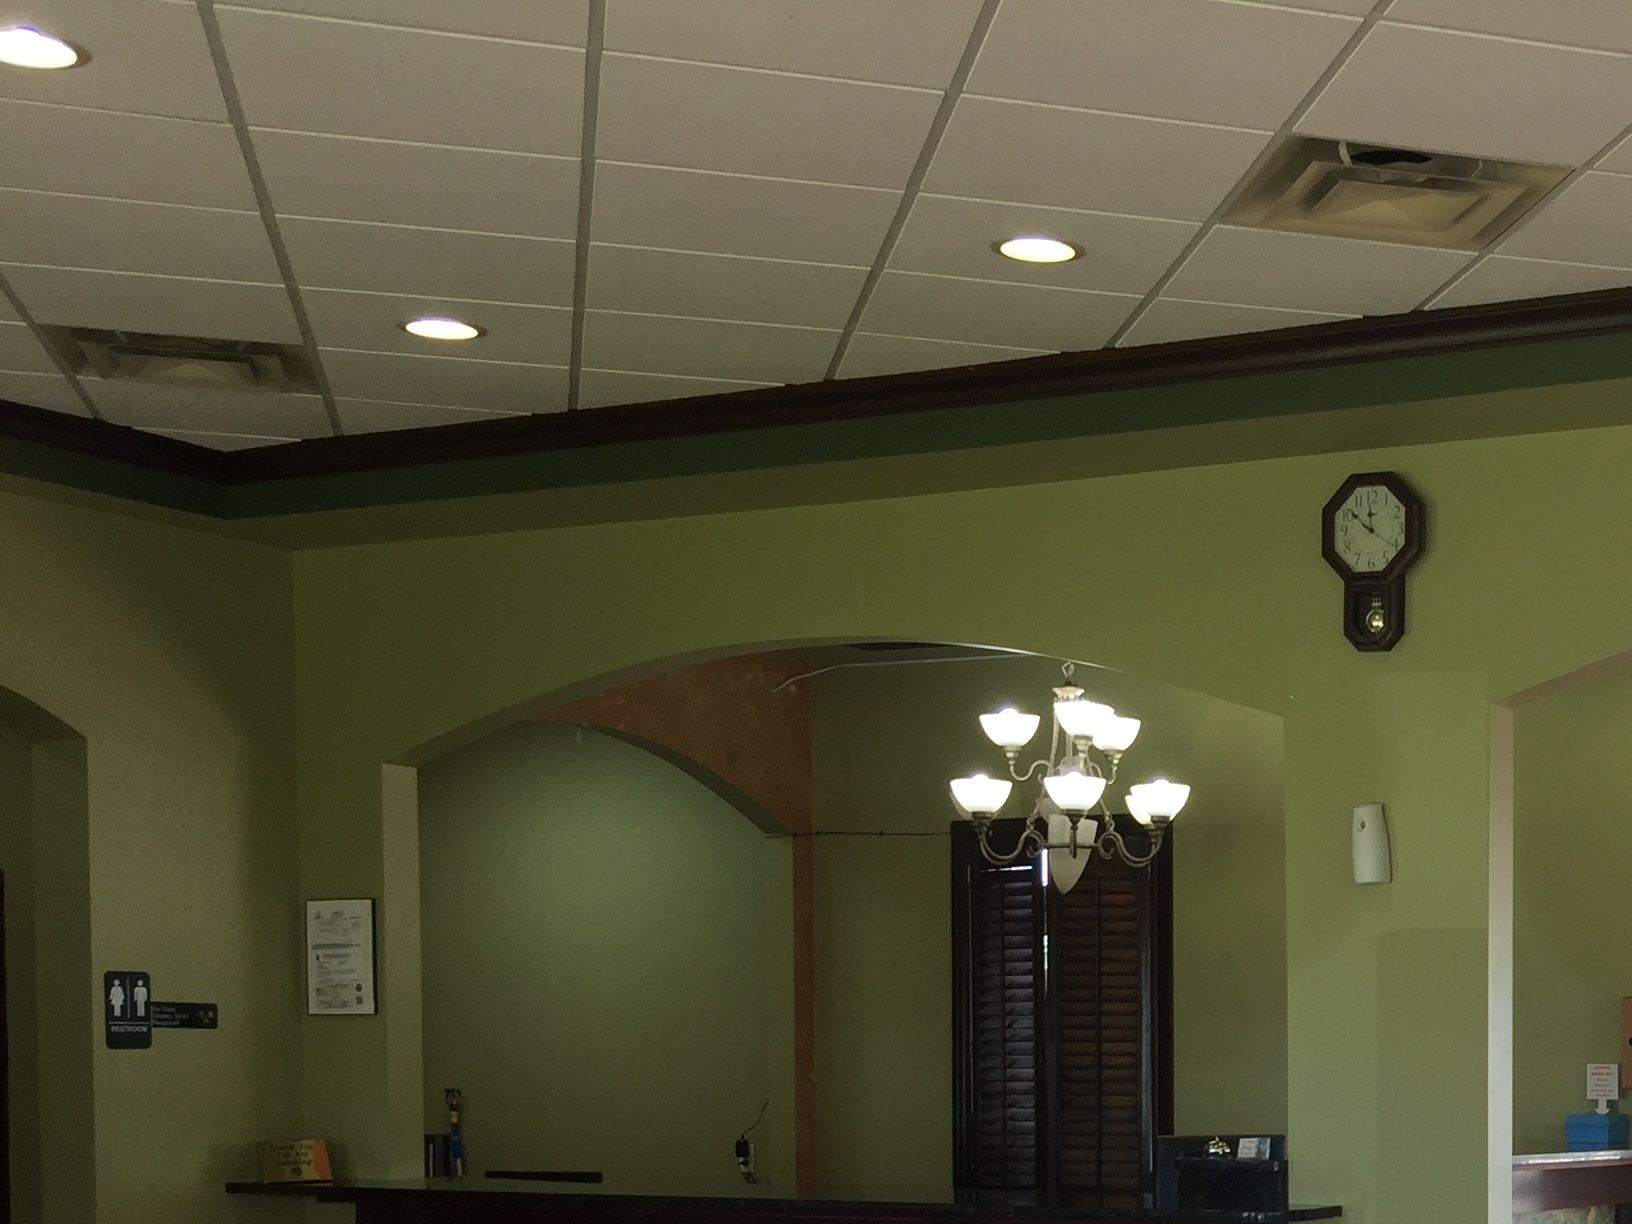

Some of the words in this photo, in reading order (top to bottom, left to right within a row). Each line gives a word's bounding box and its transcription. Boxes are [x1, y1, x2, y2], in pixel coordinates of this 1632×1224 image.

[1355, 495, 1363, 508] 11
[1367, 490, 1378, 504] 12
[1393, 505, 1400, 519] 2
[1340, 525, 1348, 536] 9
[1397, 521, 1404, 535] 3
[1344, 541, 1351, 554] 8
[1392, 538, 1400, 552] 4
[1354, 552, 1361, 565] 7
[1367, 558, 1376, 568] 6
[1383, 550, 1389, 564] 5
